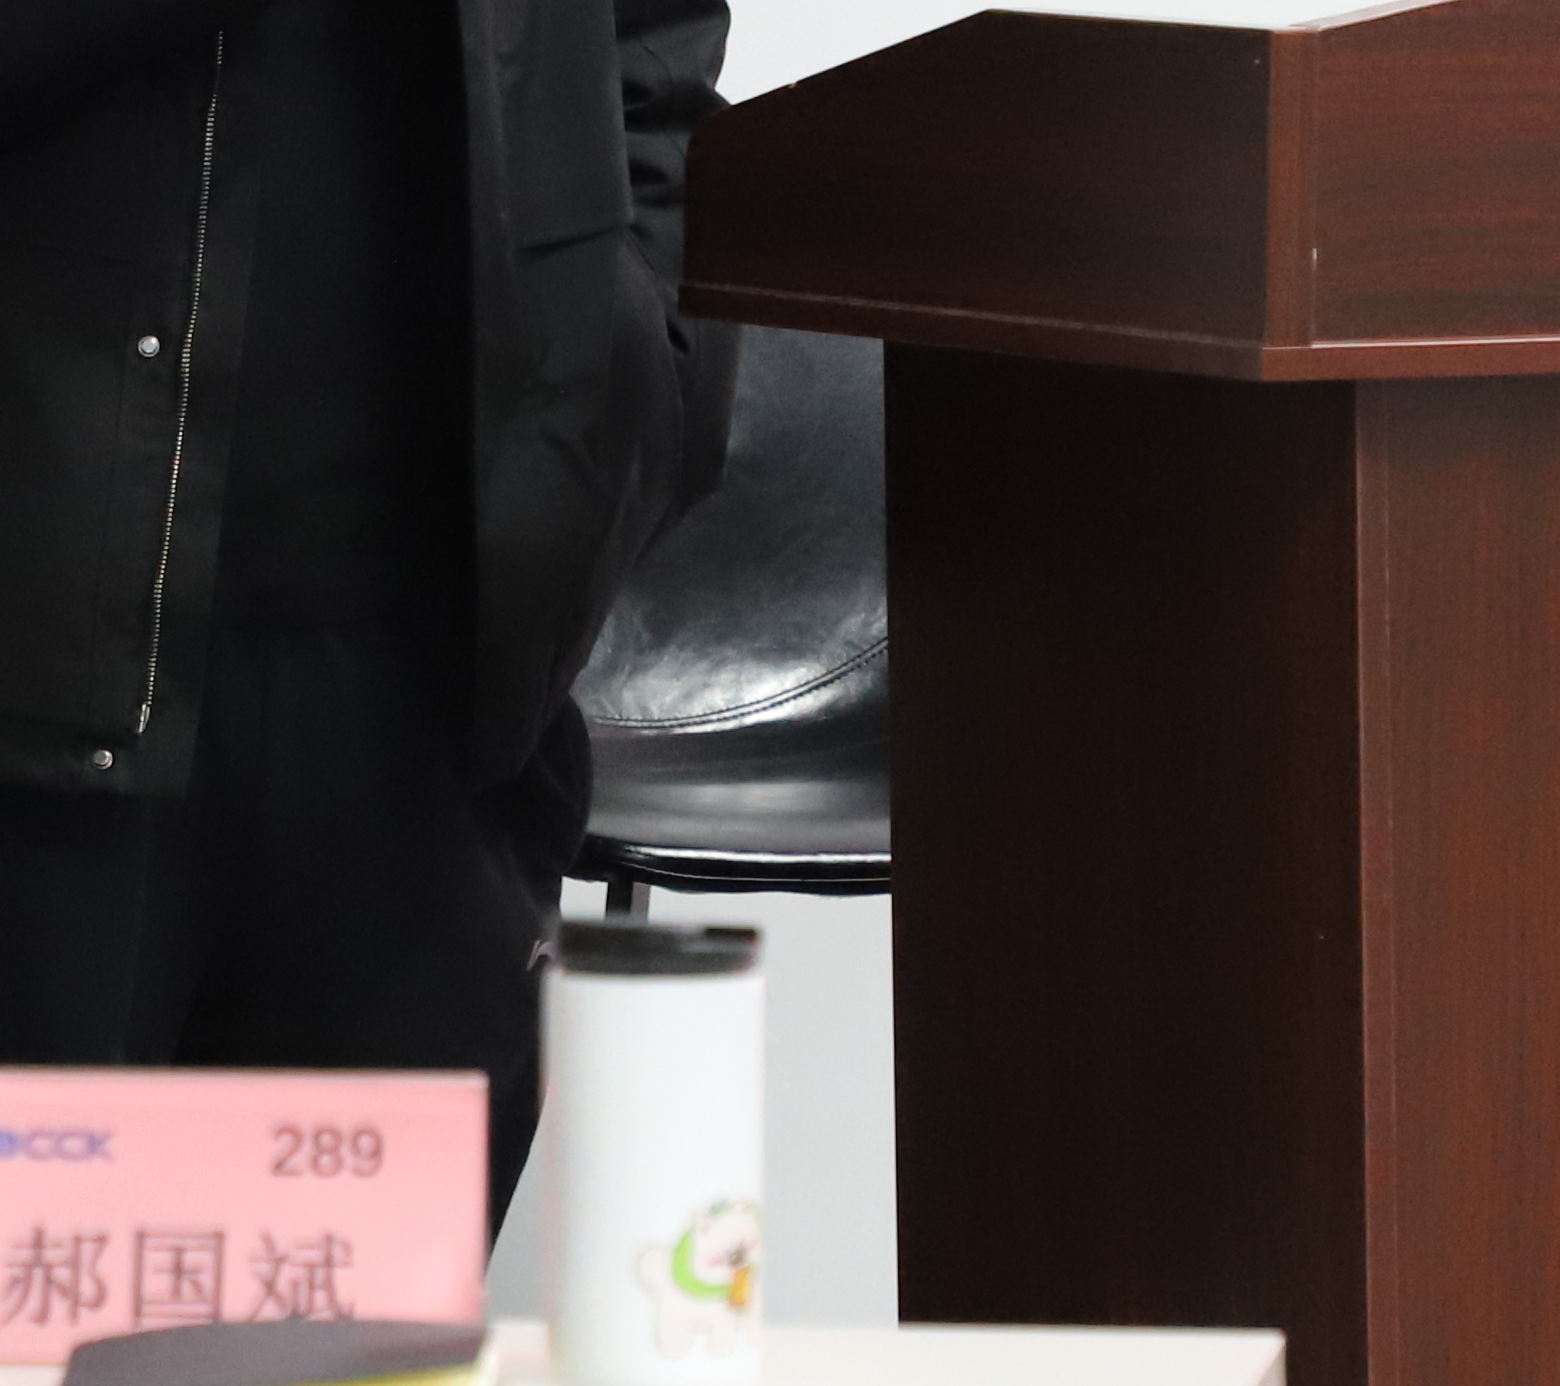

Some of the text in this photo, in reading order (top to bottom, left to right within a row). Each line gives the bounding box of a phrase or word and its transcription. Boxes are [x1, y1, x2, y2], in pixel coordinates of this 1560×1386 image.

[271, 1123, 385, 1177] 289
[2, 1226, 358, 1330] 郝国斌
